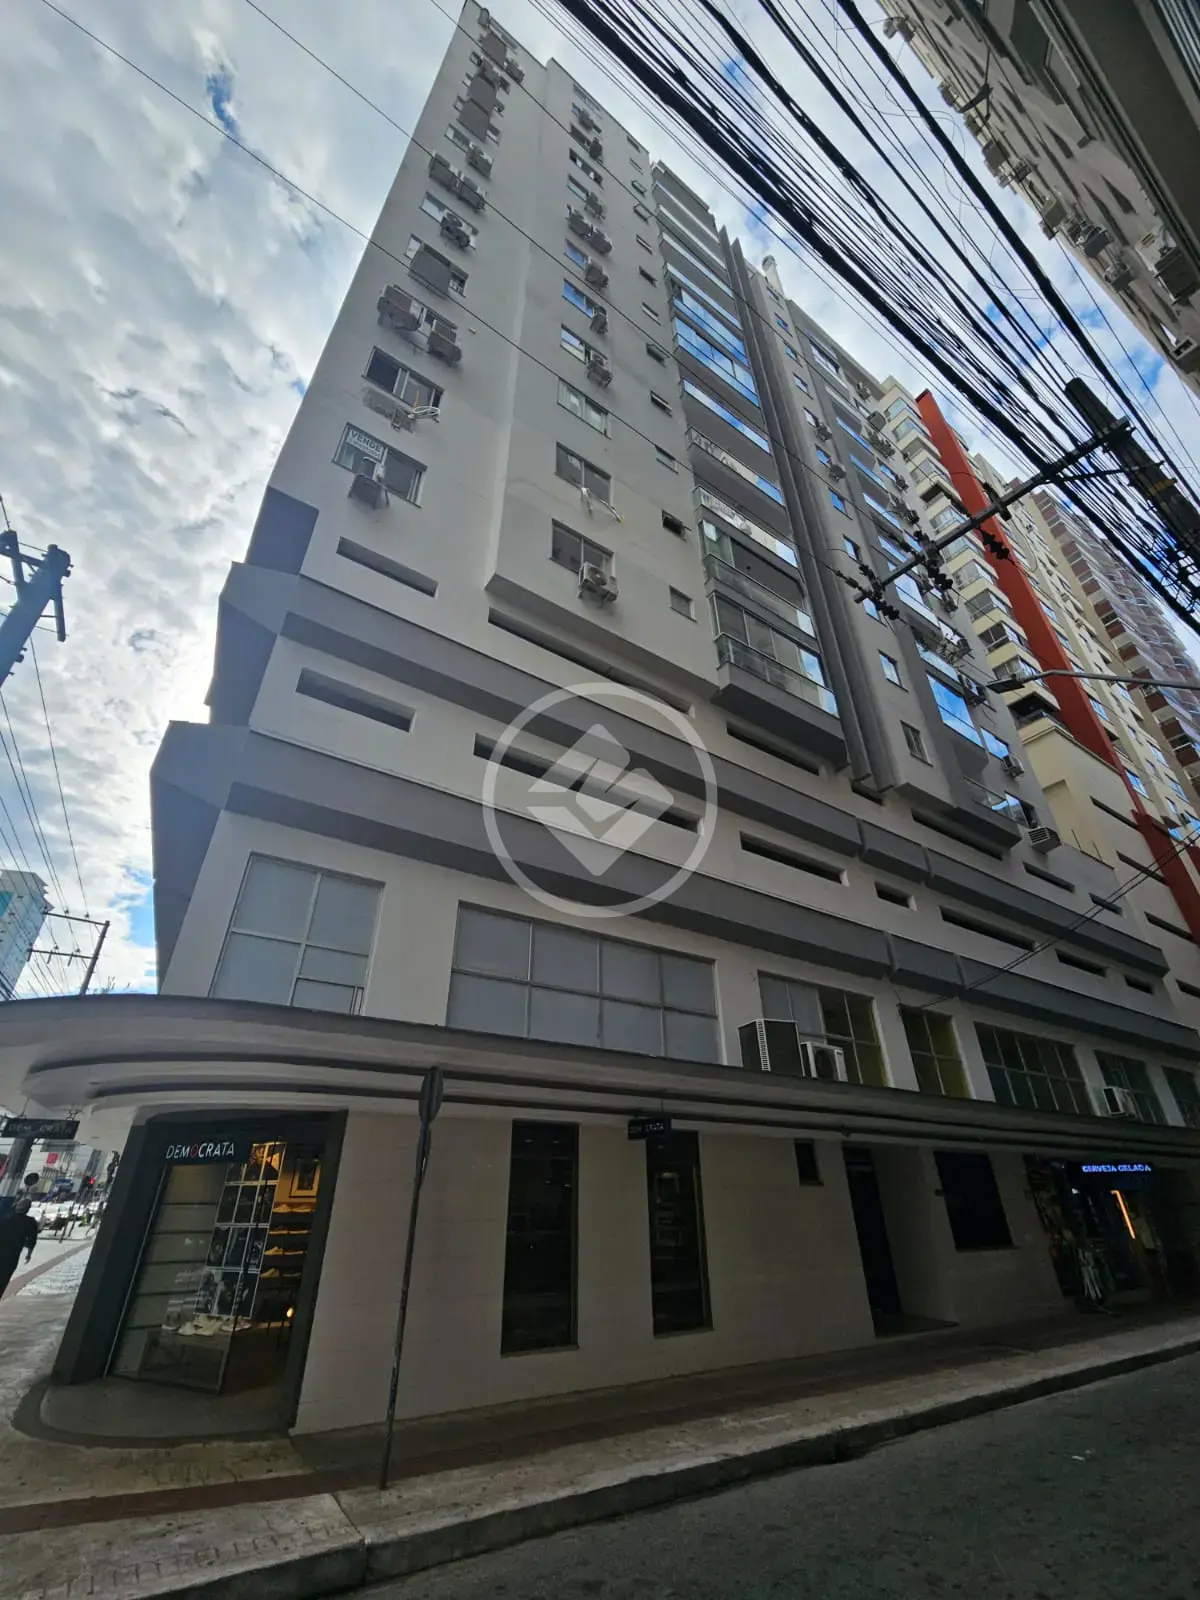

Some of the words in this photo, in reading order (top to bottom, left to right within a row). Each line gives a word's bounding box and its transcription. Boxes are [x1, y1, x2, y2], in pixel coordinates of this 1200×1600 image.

[351, 430, 382, 453] VENDE
[7, 1123, 72, 1135] DEMCRATA
[165, 1142, 235, 1159] DEMOCRATA
[1082, 1164, 1117, 1173] CERVEJA
